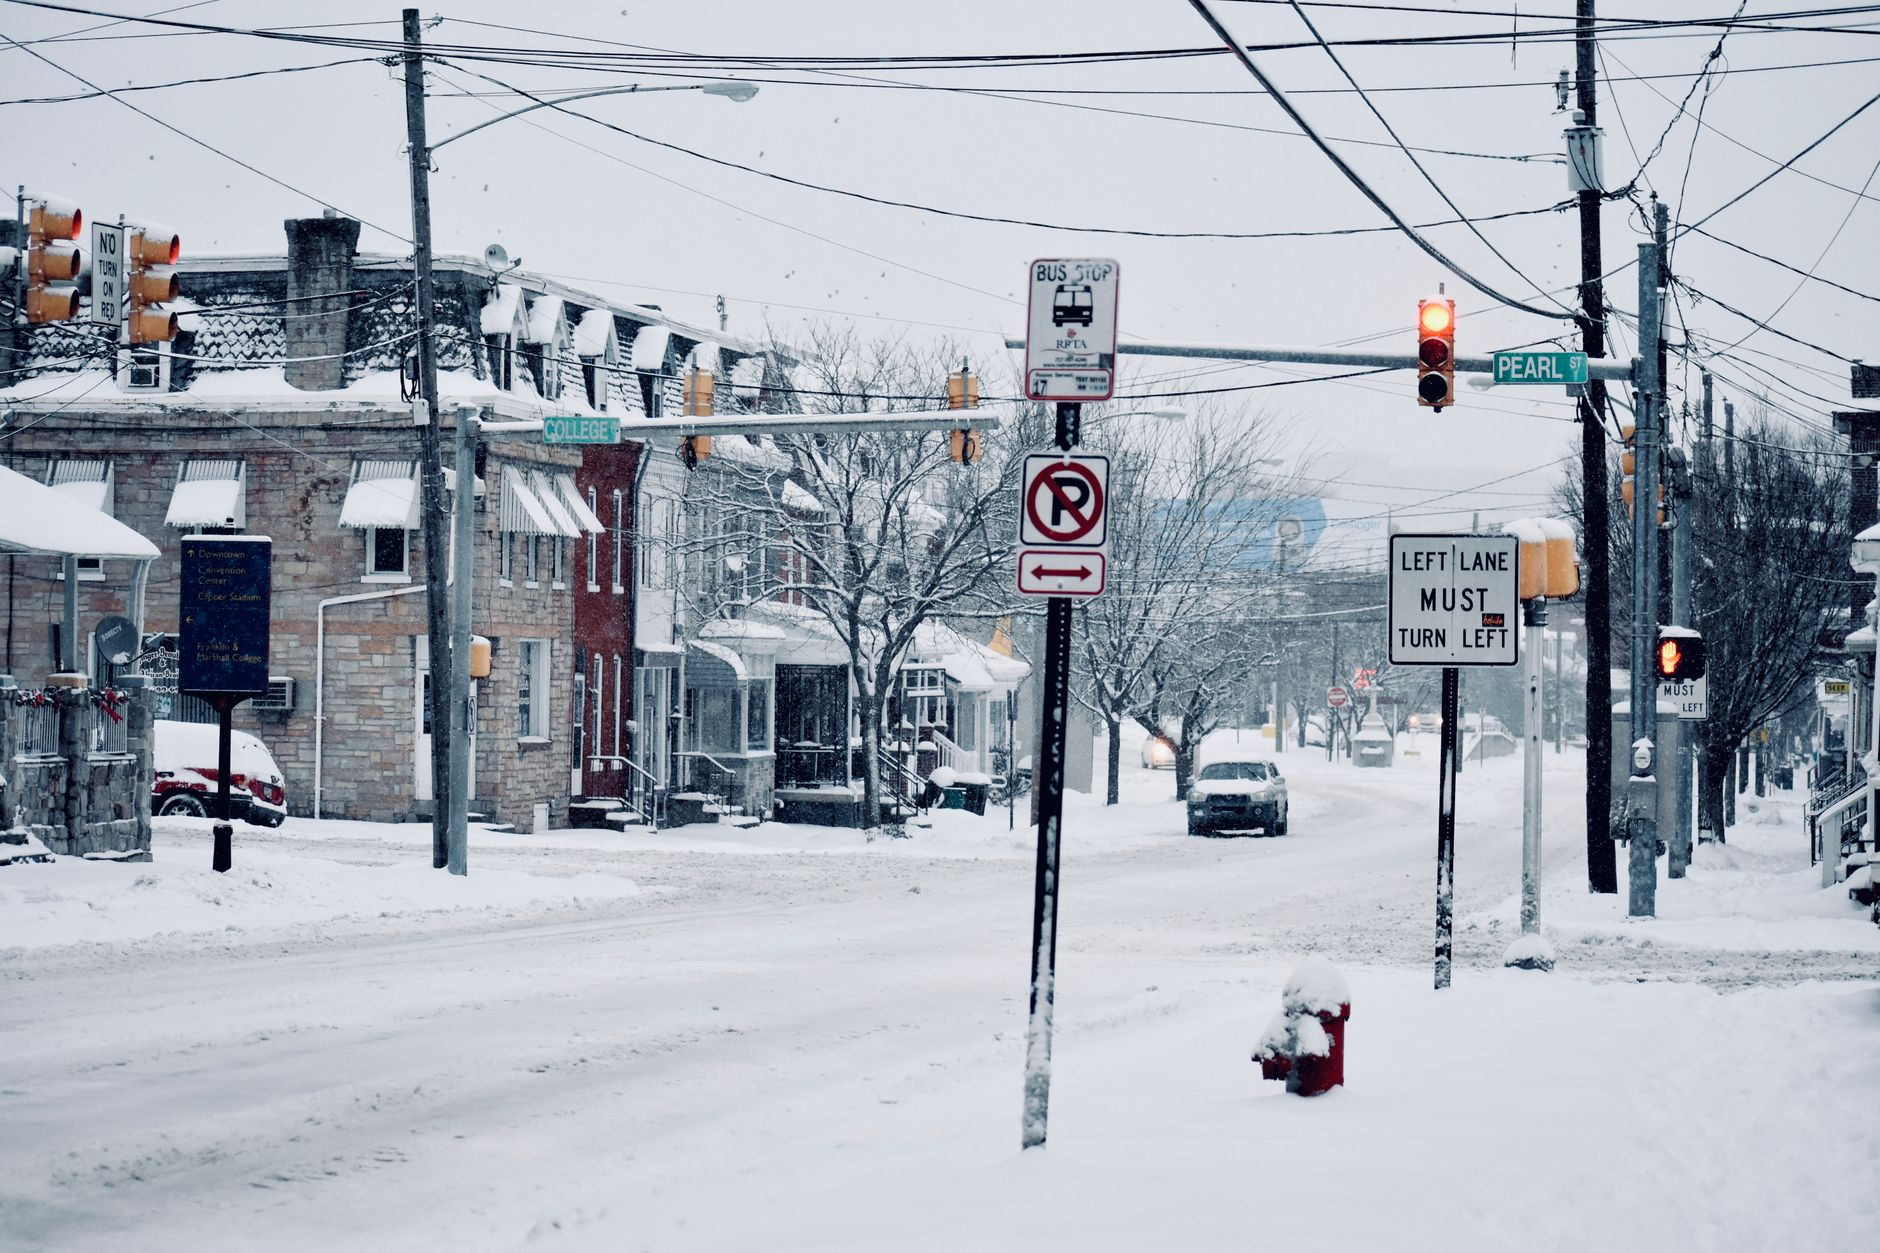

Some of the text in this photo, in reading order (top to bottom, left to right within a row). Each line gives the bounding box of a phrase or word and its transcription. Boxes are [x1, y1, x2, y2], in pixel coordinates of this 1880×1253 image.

[100, 231, 116, 255] NO
[98, 260, 117, 277] TURN
[1037, 264, 1112, 282] BUS STOP
[103, 281, 113, 297] ON
[101, 301, 115, 319] RED
[1498, 356, 1582, 379] PEARL ST
[1033, 380, 1048, 396] 17
[545, 420, 608, 440] COLLEGE
[199, 549, 245, 558] Downtown
[1402, 551, 1508, 571] LEFT LANE
[230, 592, 260, 601] Stadium
[1421, 588, 1488, 612] MUST
[1399, 628, 1508, 648] TURN LEFT
[1664, 685, 1694, 696] MUST
[1682, 703, 1703, 712] LEFT
